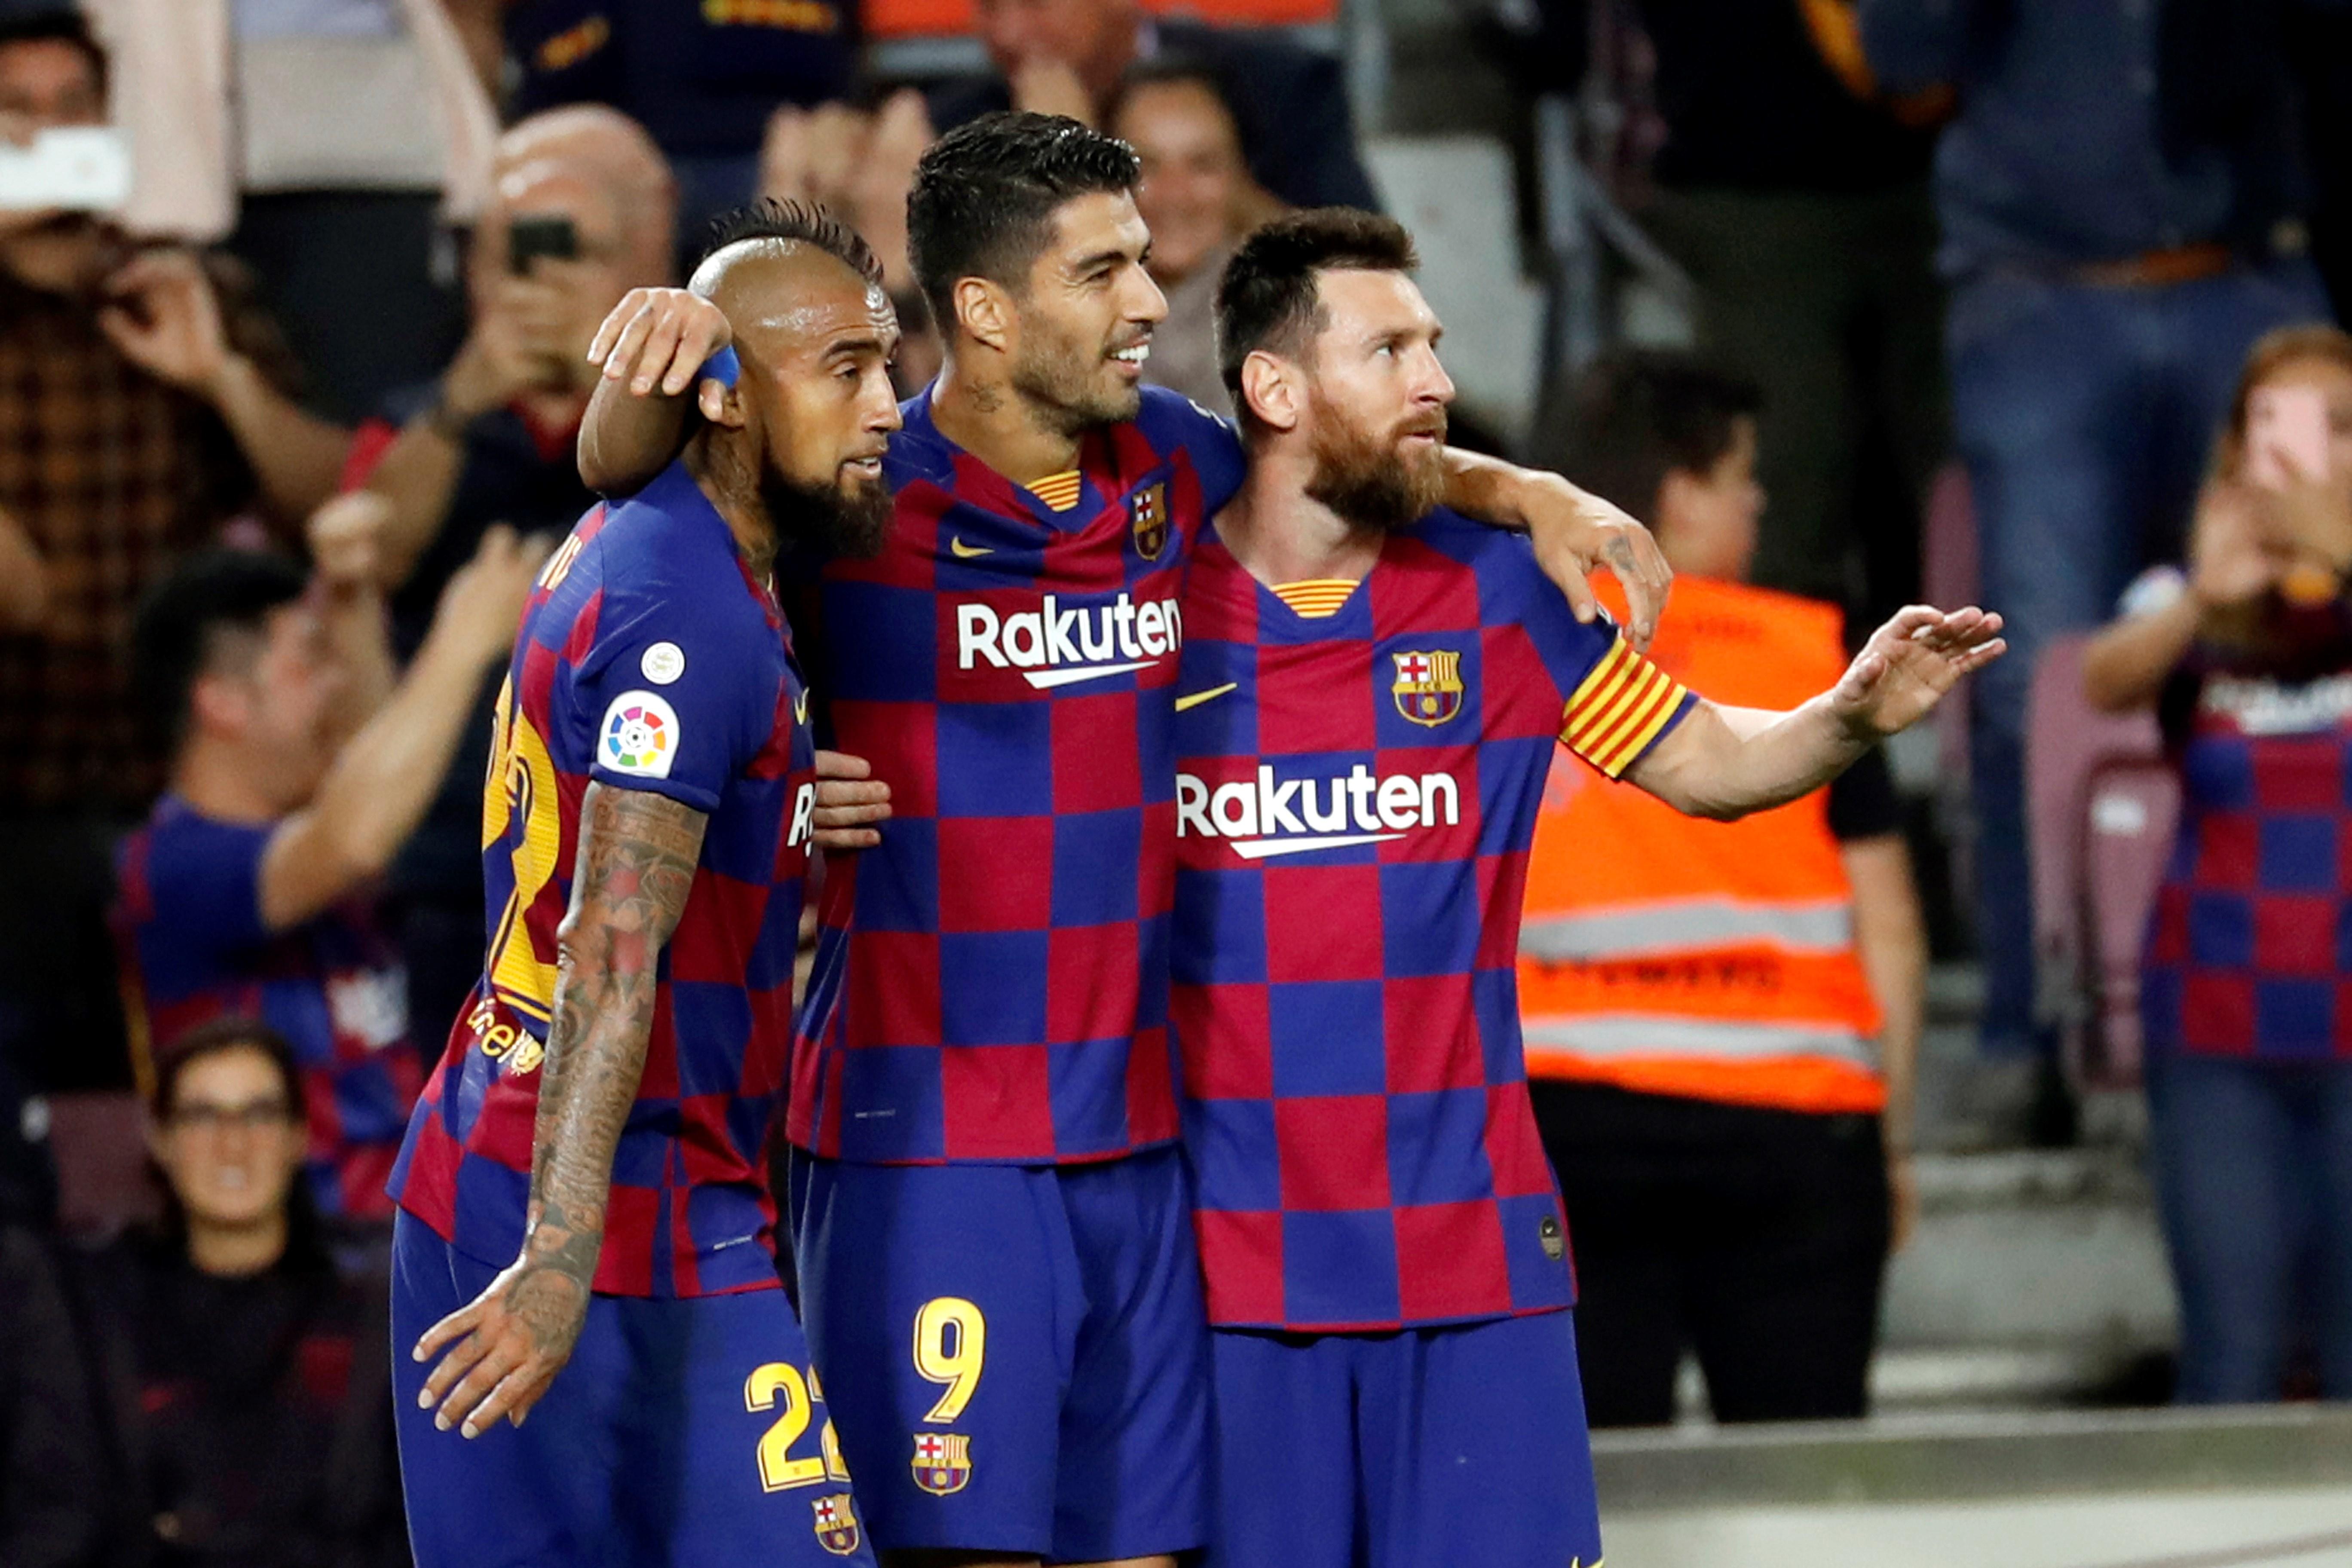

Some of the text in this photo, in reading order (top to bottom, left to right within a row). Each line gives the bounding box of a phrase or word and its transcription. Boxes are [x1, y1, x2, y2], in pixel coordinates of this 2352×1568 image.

[957, 593, 1181, 669] Rakuten
[1176, 765, 1459, 837] Rakuten
[912, 1296, 985, 1423] 9
